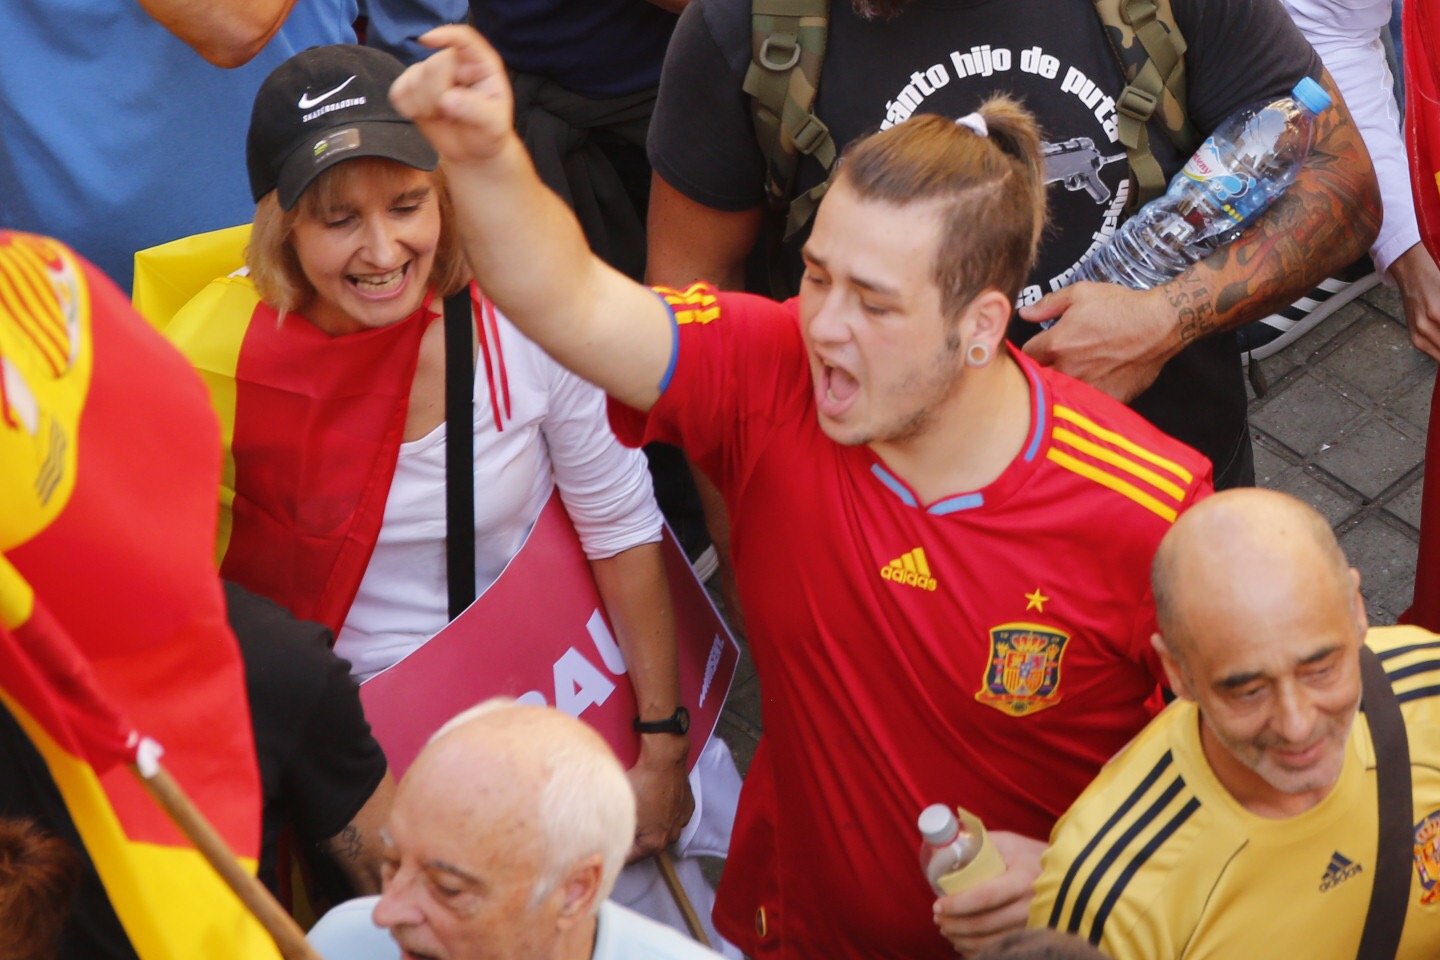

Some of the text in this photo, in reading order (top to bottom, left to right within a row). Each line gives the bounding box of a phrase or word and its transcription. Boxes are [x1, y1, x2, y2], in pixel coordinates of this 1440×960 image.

[950, 45, 1012, 78] hijo
[1020, 46, 1060, 79] de
[1060, 65, 1119, 144] puta
[303, 96, 366, 123] SKATEBOARDING
[880, 565, 938, 592] adidas
[1319, 864, 1363, 893] adidas
